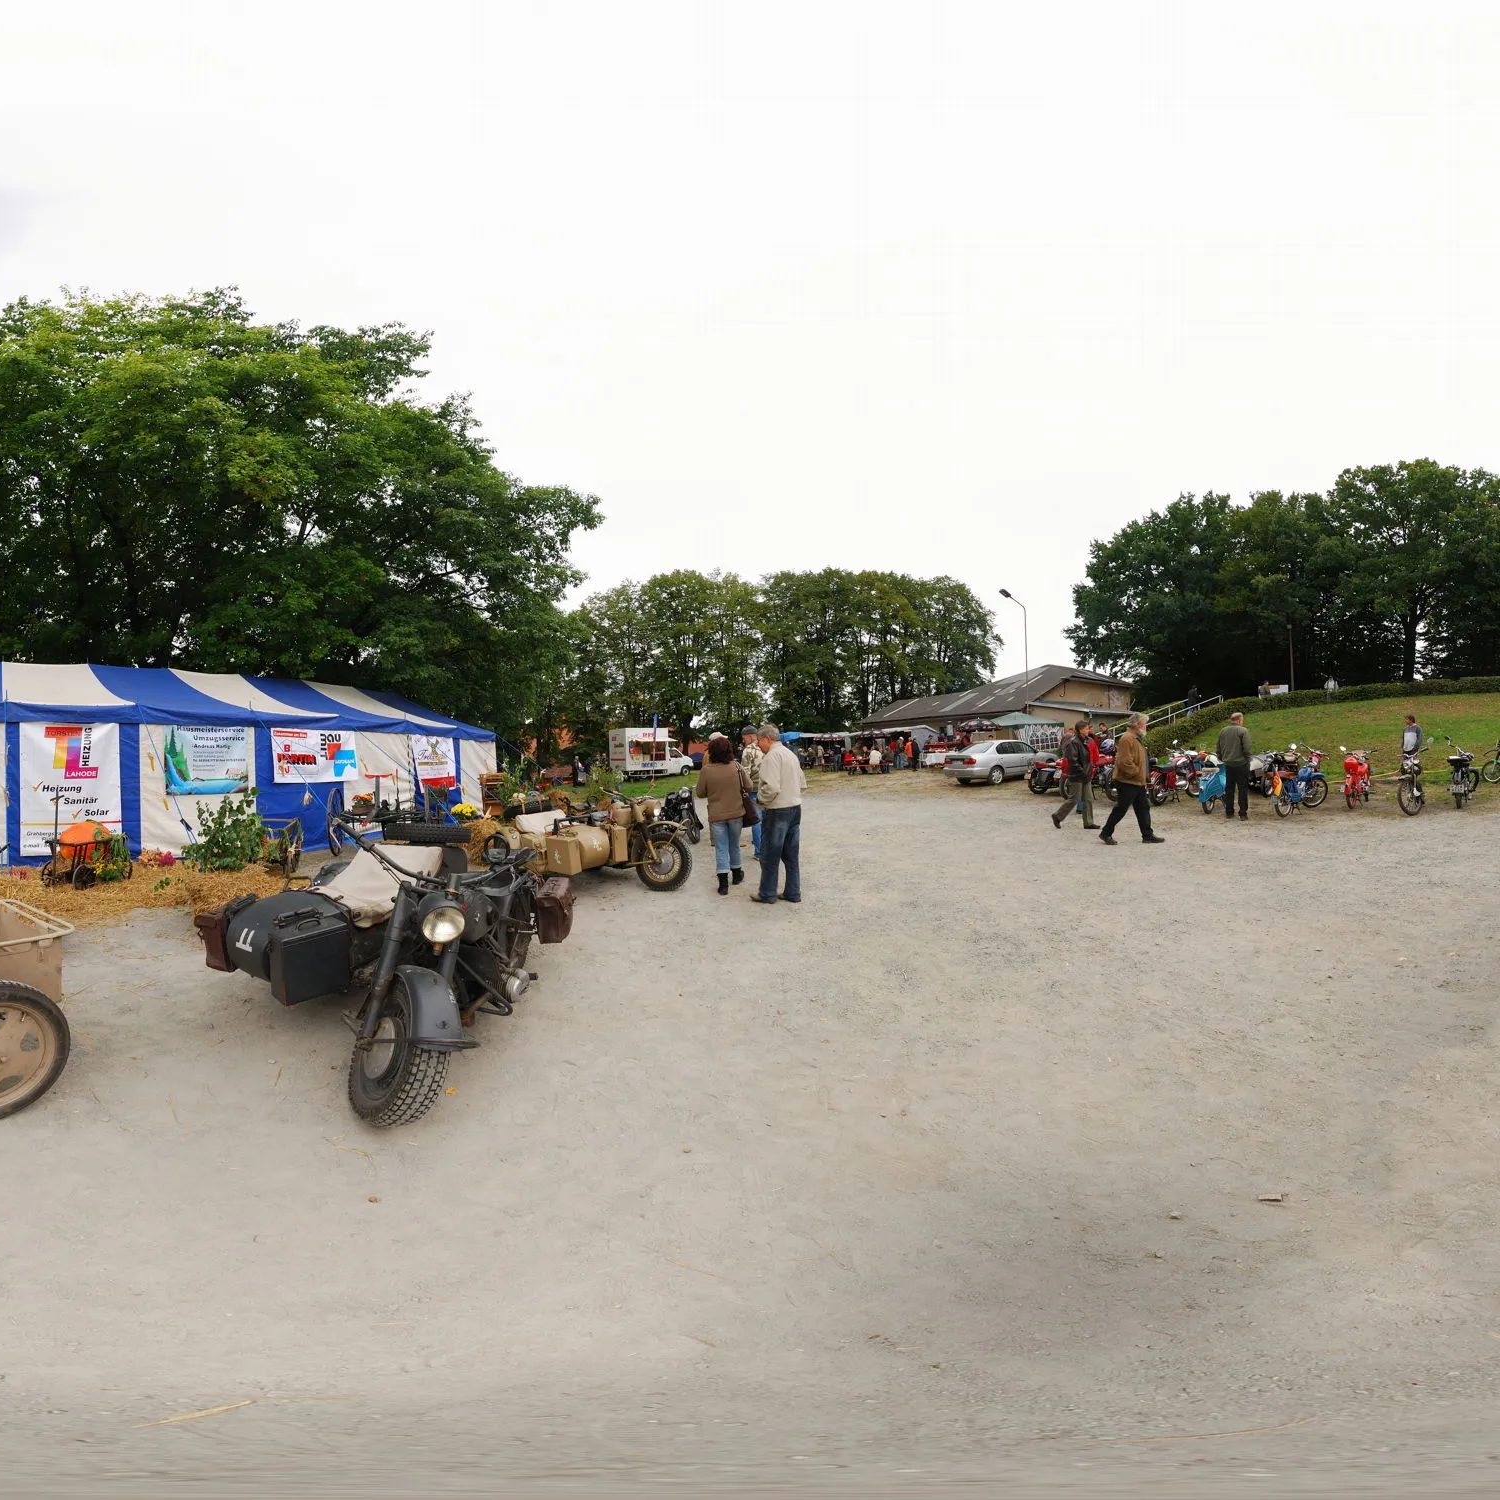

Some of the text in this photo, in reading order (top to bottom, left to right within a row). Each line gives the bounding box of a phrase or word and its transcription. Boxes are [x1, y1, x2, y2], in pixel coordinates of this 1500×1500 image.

[81, 727, 93, 767] HEIZUNG
[42, 784, 82, 795] Heizung
[64, 797, 99, 805] Sanitär
[85, 808, 110, 817] Solar
